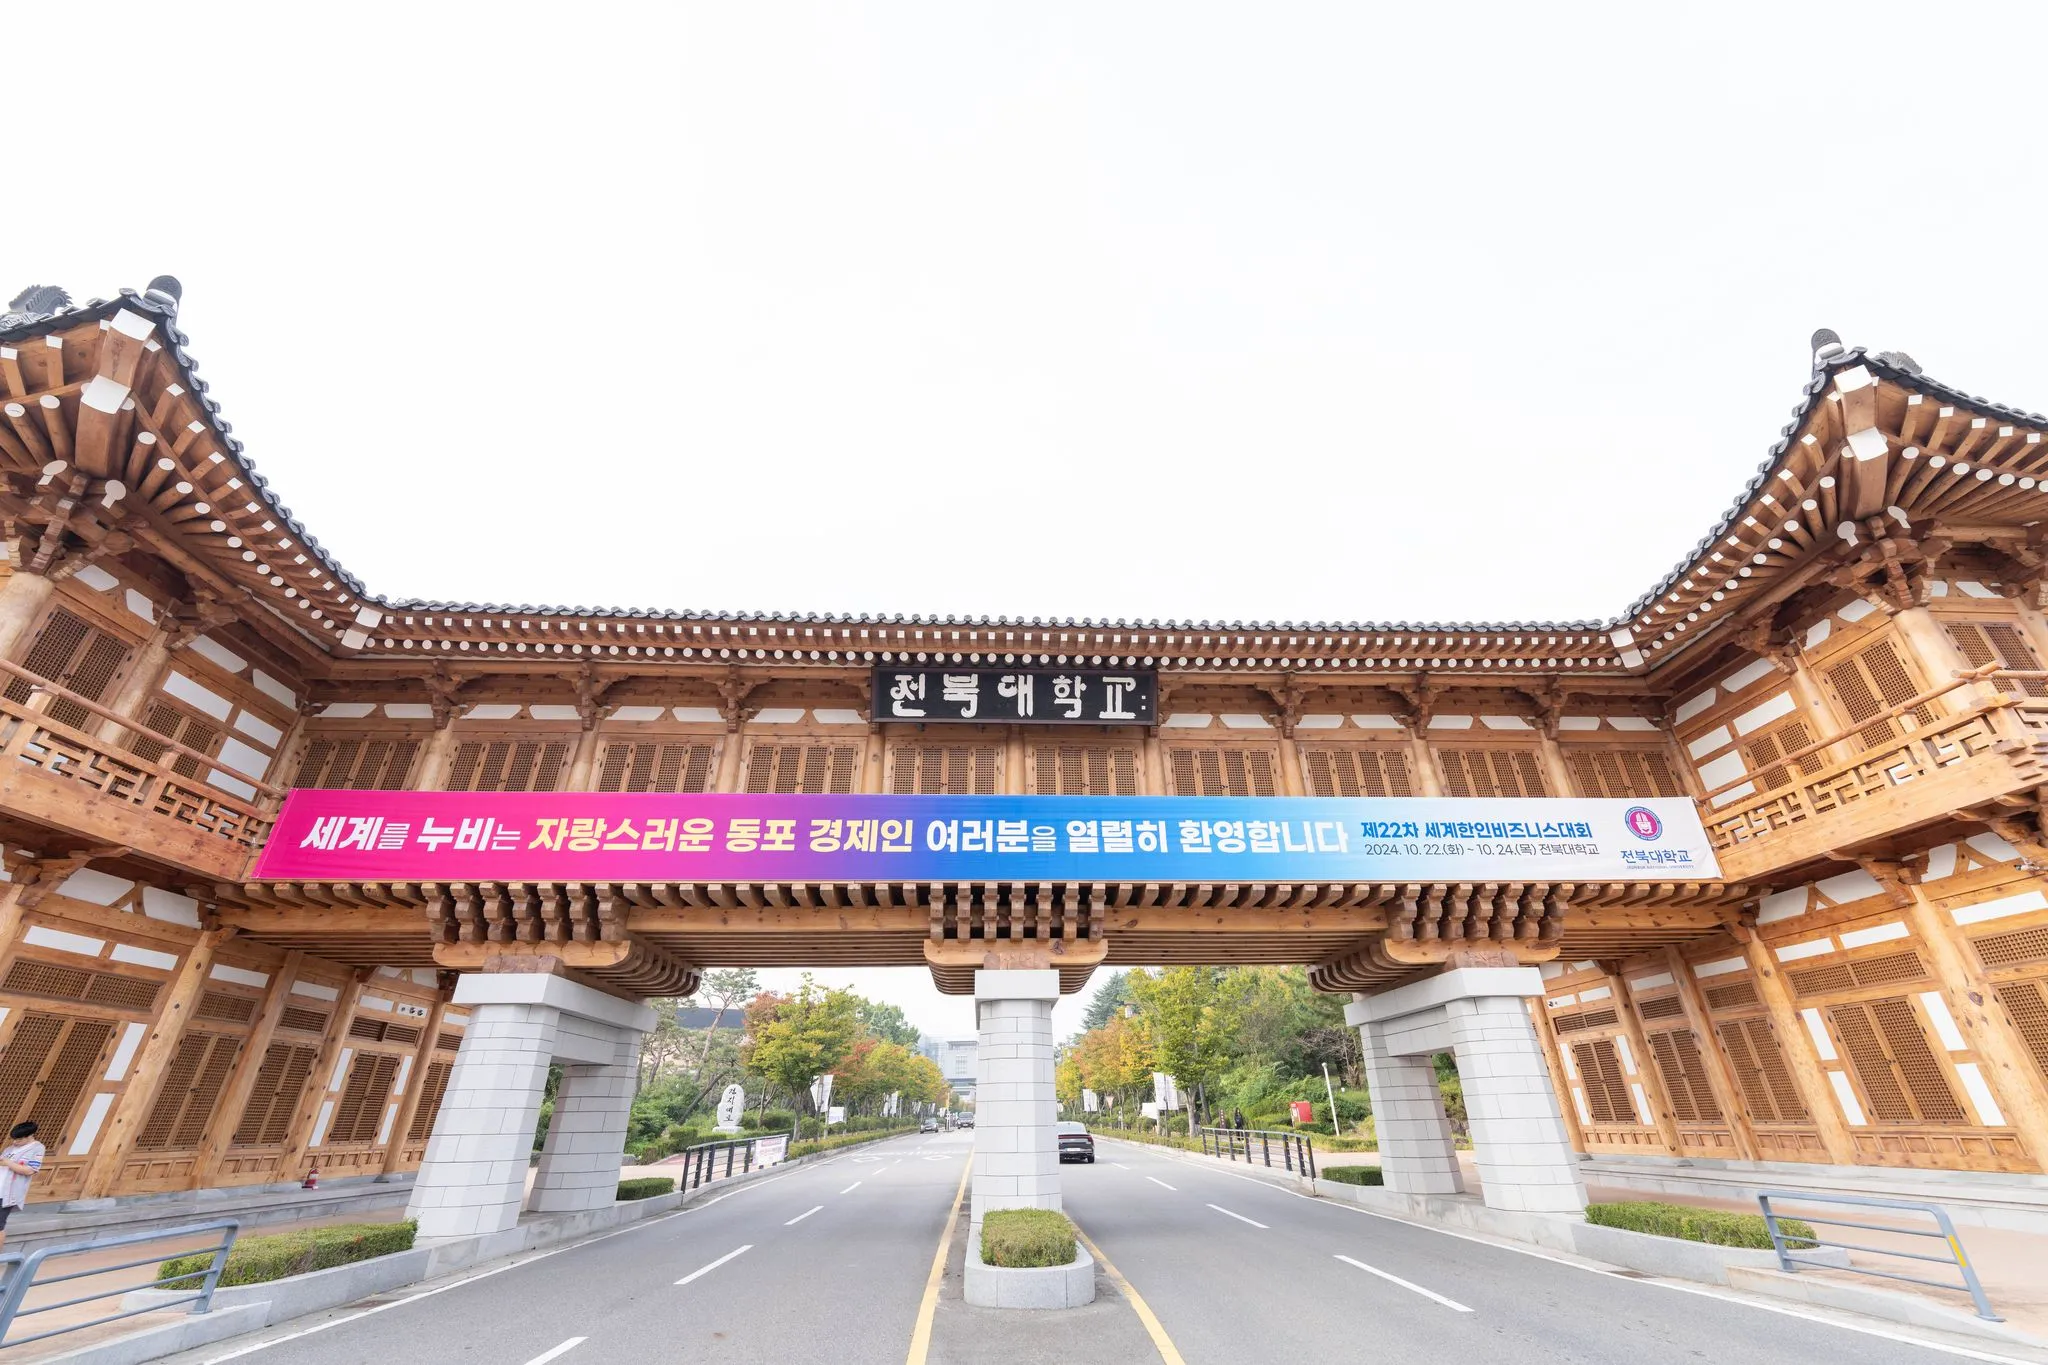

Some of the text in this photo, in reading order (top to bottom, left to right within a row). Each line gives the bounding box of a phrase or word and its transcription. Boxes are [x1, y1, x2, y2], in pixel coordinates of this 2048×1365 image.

[300, 816, 1349, 853] 세계를 누비는 자랑스러운 동포 경제인 여러분을 열렬히 환영합니다
[1361, 822, 1593, 838] 제22차 세계한인비즈니스대회
[1538, 843, 1600, 855] 전북대학교
[1620, 849, 1692, 864] 전북대학교
